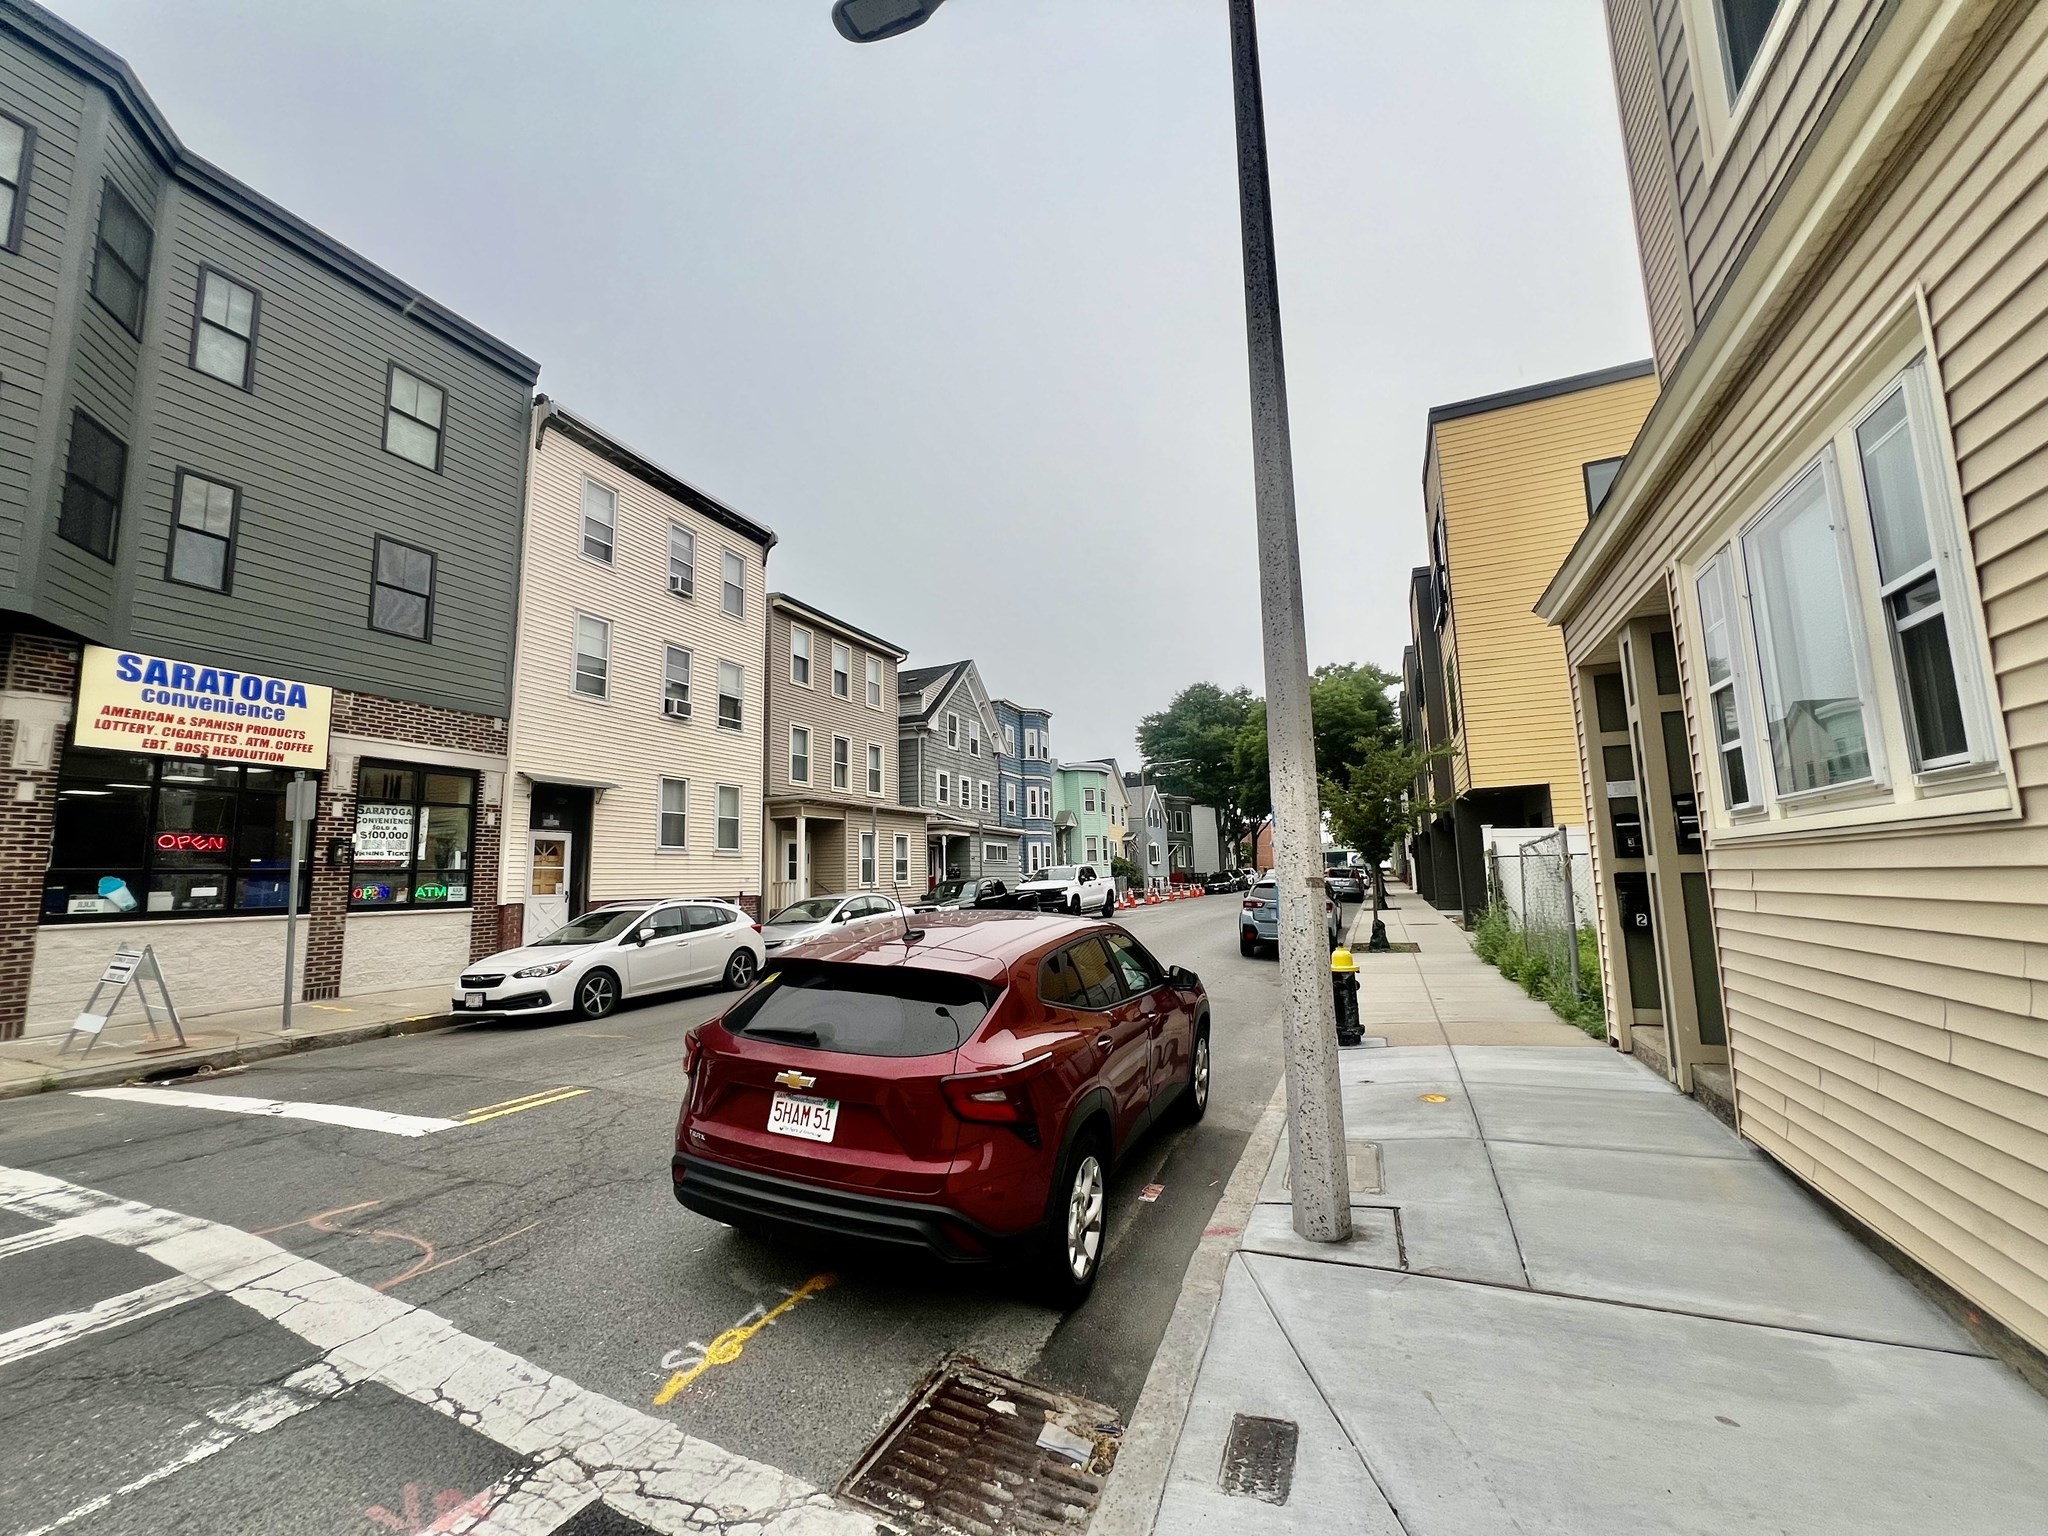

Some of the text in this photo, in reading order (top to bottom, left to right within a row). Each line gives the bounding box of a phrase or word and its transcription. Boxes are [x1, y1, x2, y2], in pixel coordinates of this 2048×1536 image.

[116, 653, 307, 709] SARATOGA
[141, 688, 286, 722] convenience
[100, 704, 306, 740] AMERICAN & SPANISH PRODUCTS
[174, 741, 210, 754] BOSS
[212, 745, 285, 762] REVOLUTION
[275, 740, 314, 754] COFFEE
[357, 805, 412, 816] SARATOGA
[356, 816, 414, 825] CONVENIENCE
[158, 834, 224, 850] OPEN
[360, 831, 409, 840] $100,000
[352, 885, 390, 900] OPEN
[415, 885, 447, 898] ATM
[1637, 914, 1647, 926] 2
[773, 1101, 812, 1127] 5HAM
[813, 1107, 832, 1132] 51
